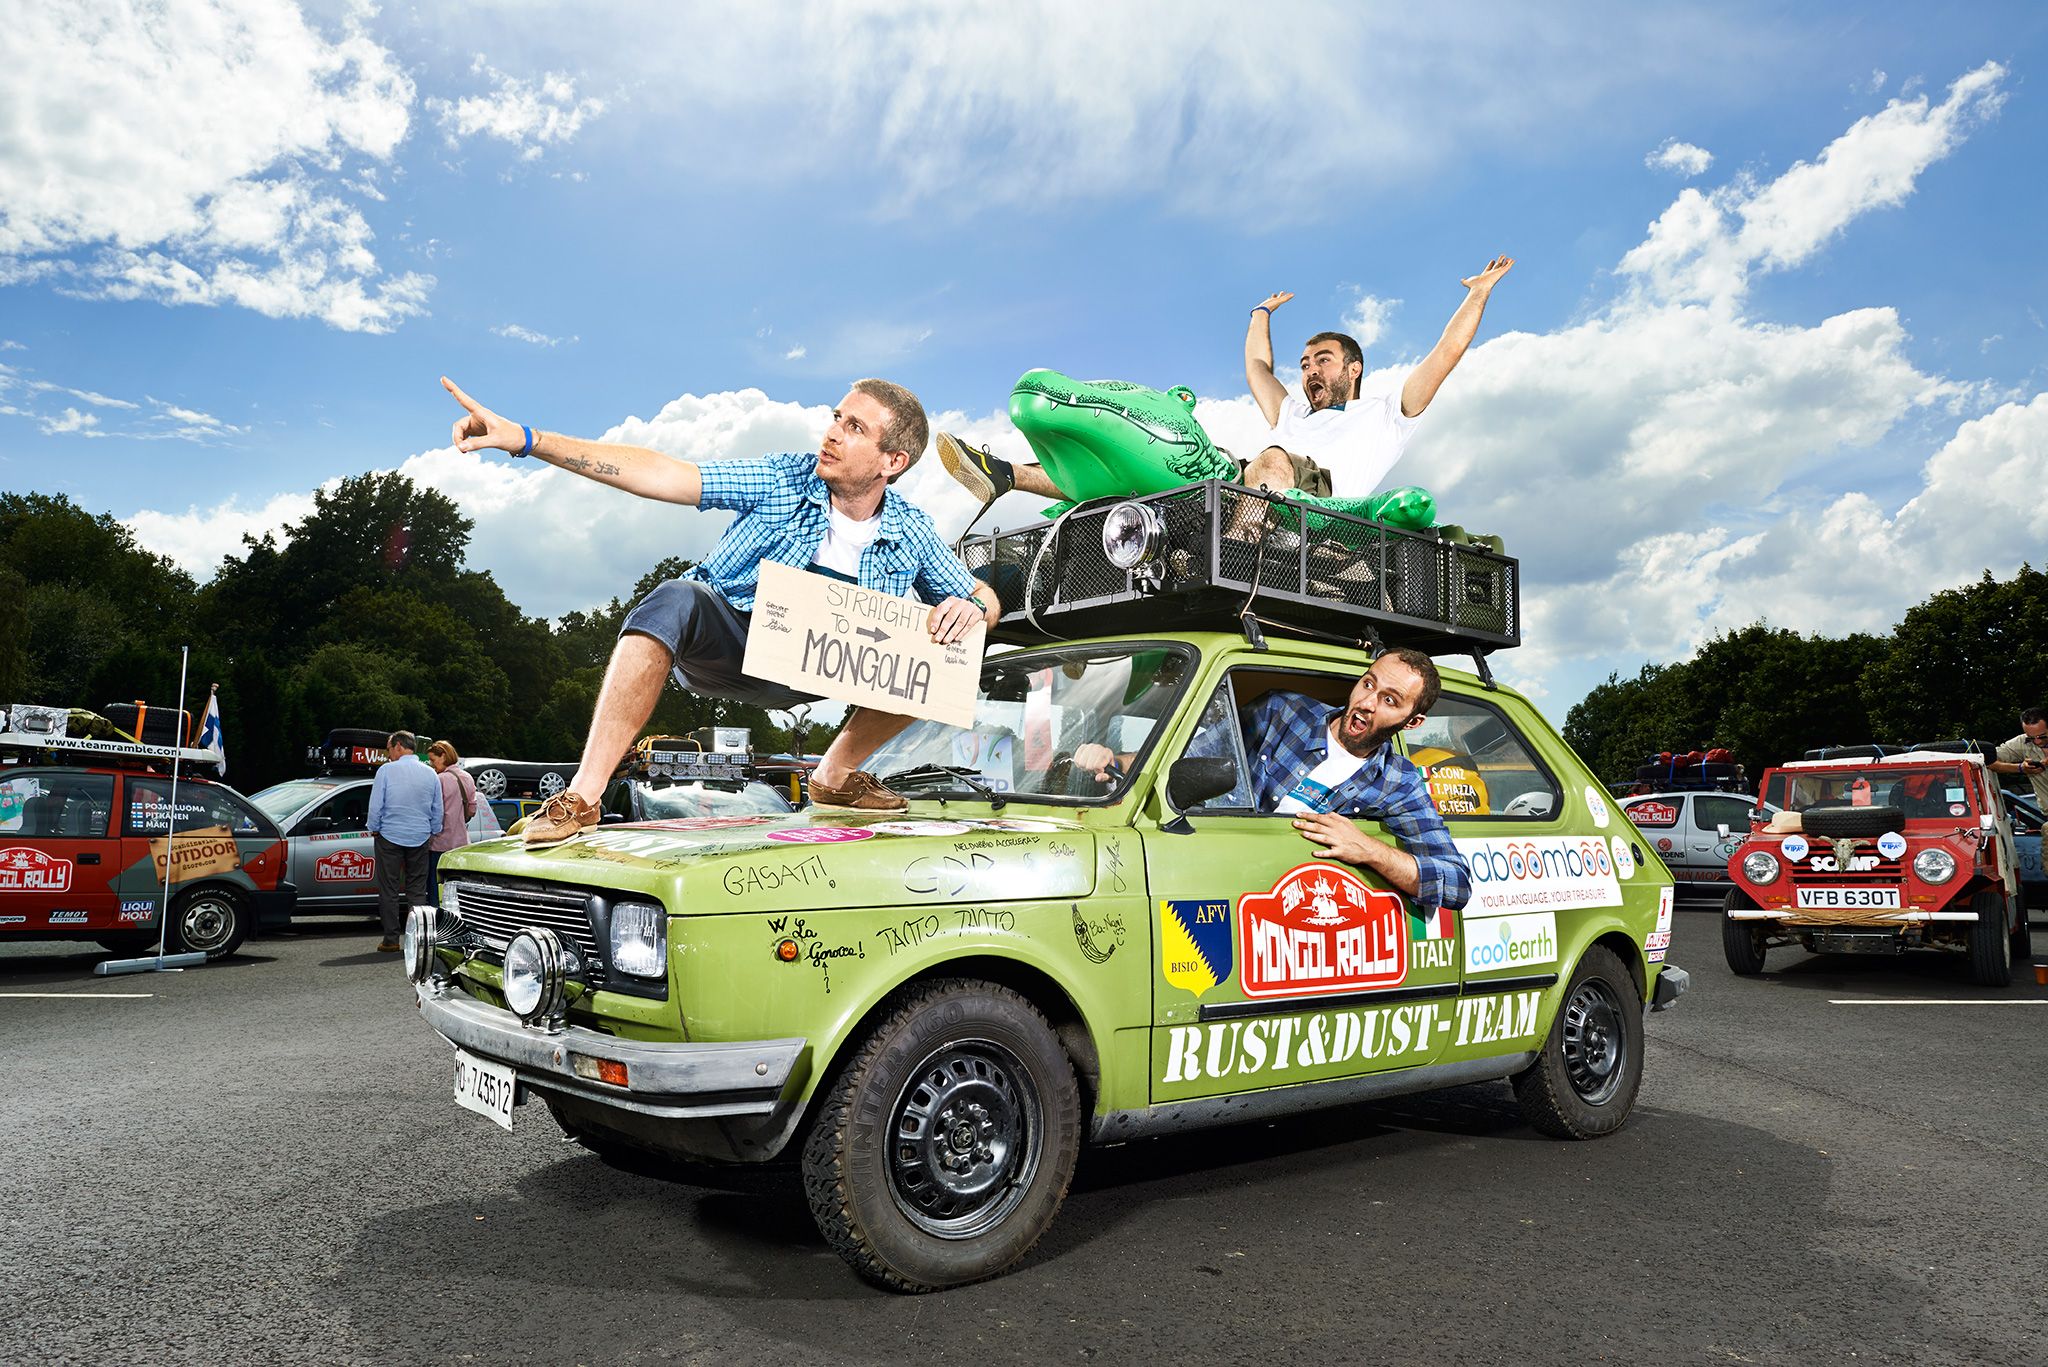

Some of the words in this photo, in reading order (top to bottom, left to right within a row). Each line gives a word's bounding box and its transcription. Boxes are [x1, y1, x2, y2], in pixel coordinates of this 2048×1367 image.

[826, 583, 927, 632] STRAIGHT
[831, 612, 850, 634] TO
[801, 628, 931, 705] MONGOLIA
[44, 738, 182, 757] www.teamramble.com
[1431, 766, 1466, 780] S.CONZ
[1434, 783, 1477, 797] T.PIAZZA
[1439, 800, 1477, 813] G.TESTA
[1652, 809, 1673, 822] RALLY
[145, 819, 169, 829] MÄKI
[340, 832, 360, 840] DRIVE
[156, 841, 236, 867] OUTDOOR
[1656, 851, 1686, 859] WDENS
[318, 862, 347, 879] MONGOL
[347, 861, 372, 878] RALLY
[1810, 856, 1881, 872] SCMP
[23, 865, 67, 888] RALLY
[723, 854, 837, 896] GASATI!
[1281, 878, 1306, 916] 2004
[1341, 878, 1368, 914] 2014
[1481, 895, 1505, 908] YOUR
[1505, 891, 1551, 906] LANGUAGE,
[1551, 890, 1573, 903] YOUR
[1573, 888, 1607, 901] TREASURE
[1800, 890, 1839, 905] VFB
[1844, 890, 1898, 905] 630T
[120, 911, 152, 920] MOLY
[122, 902, 153, 912] LIQUI
[1195, 904, 1227, 924] AFV
[1250, 912, 1335, 983] MONGOL
[1336, 908, 1399, 977] RALLY
[1412, 939, 1456, 969] ITALY
[1170, 960, 1199, 973] BISIO
[471, 1066, 511, 1115] 743512
[849, 1045, 905, 1205] WINTER
[910, 1002, 965, 1043] 160
